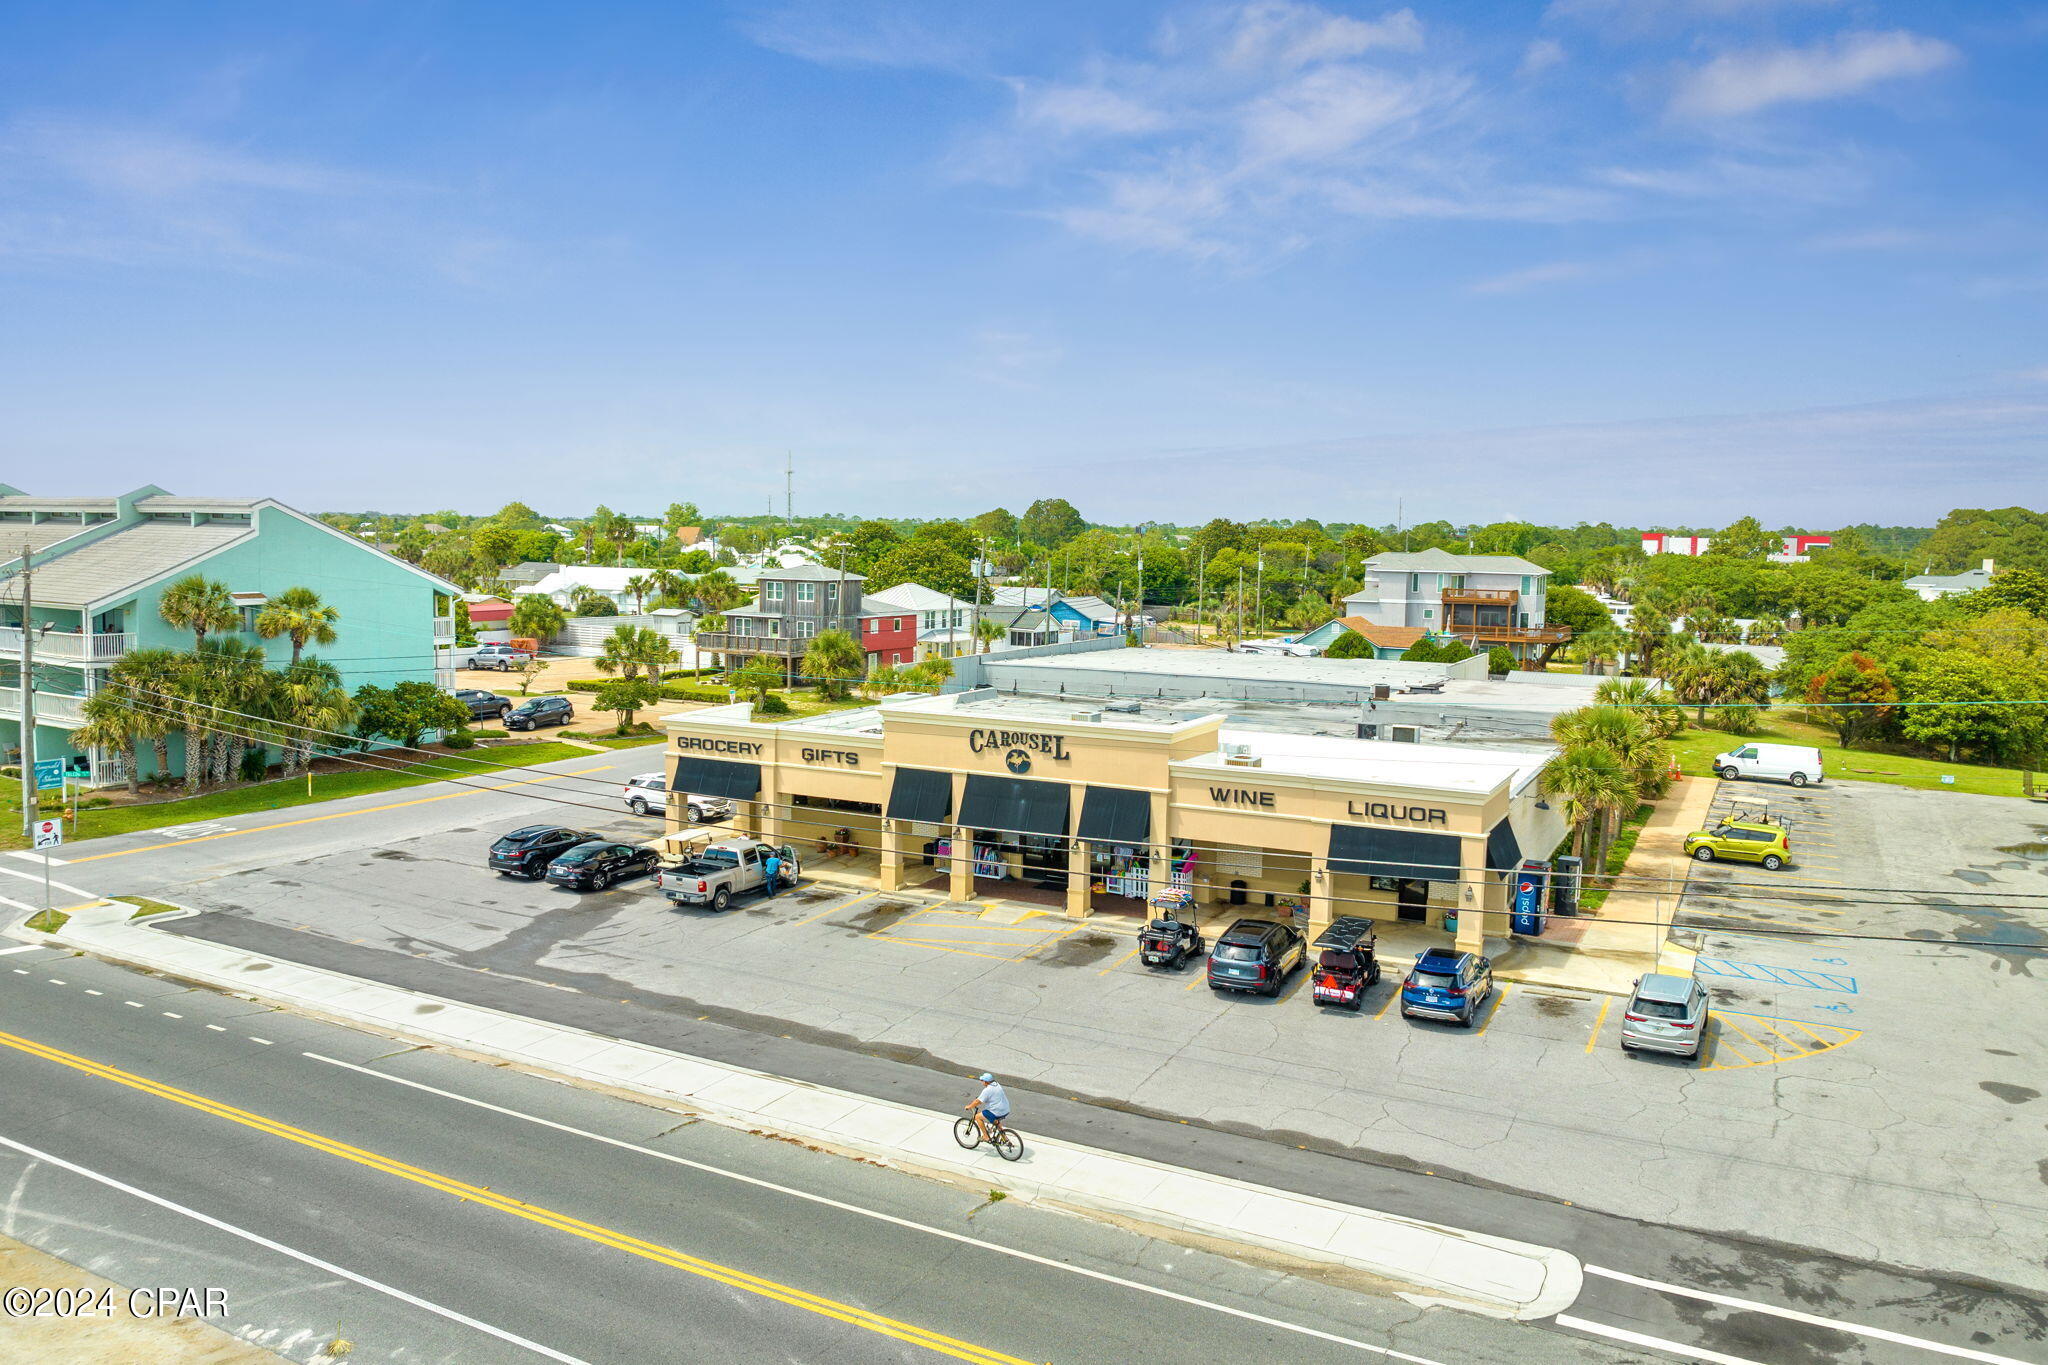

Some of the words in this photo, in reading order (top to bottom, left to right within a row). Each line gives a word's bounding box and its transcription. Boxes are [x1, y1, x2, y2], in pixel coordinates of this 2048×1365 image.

[677, 736, 763, 755] GROCERY
[969, 729, 1070, 760] CAROUSEL
[801, 747, 859, 765] GIFTS
[1209, 787, 1275, 807] WINE
[1348, 800, 1446, 824] LIQUOR
